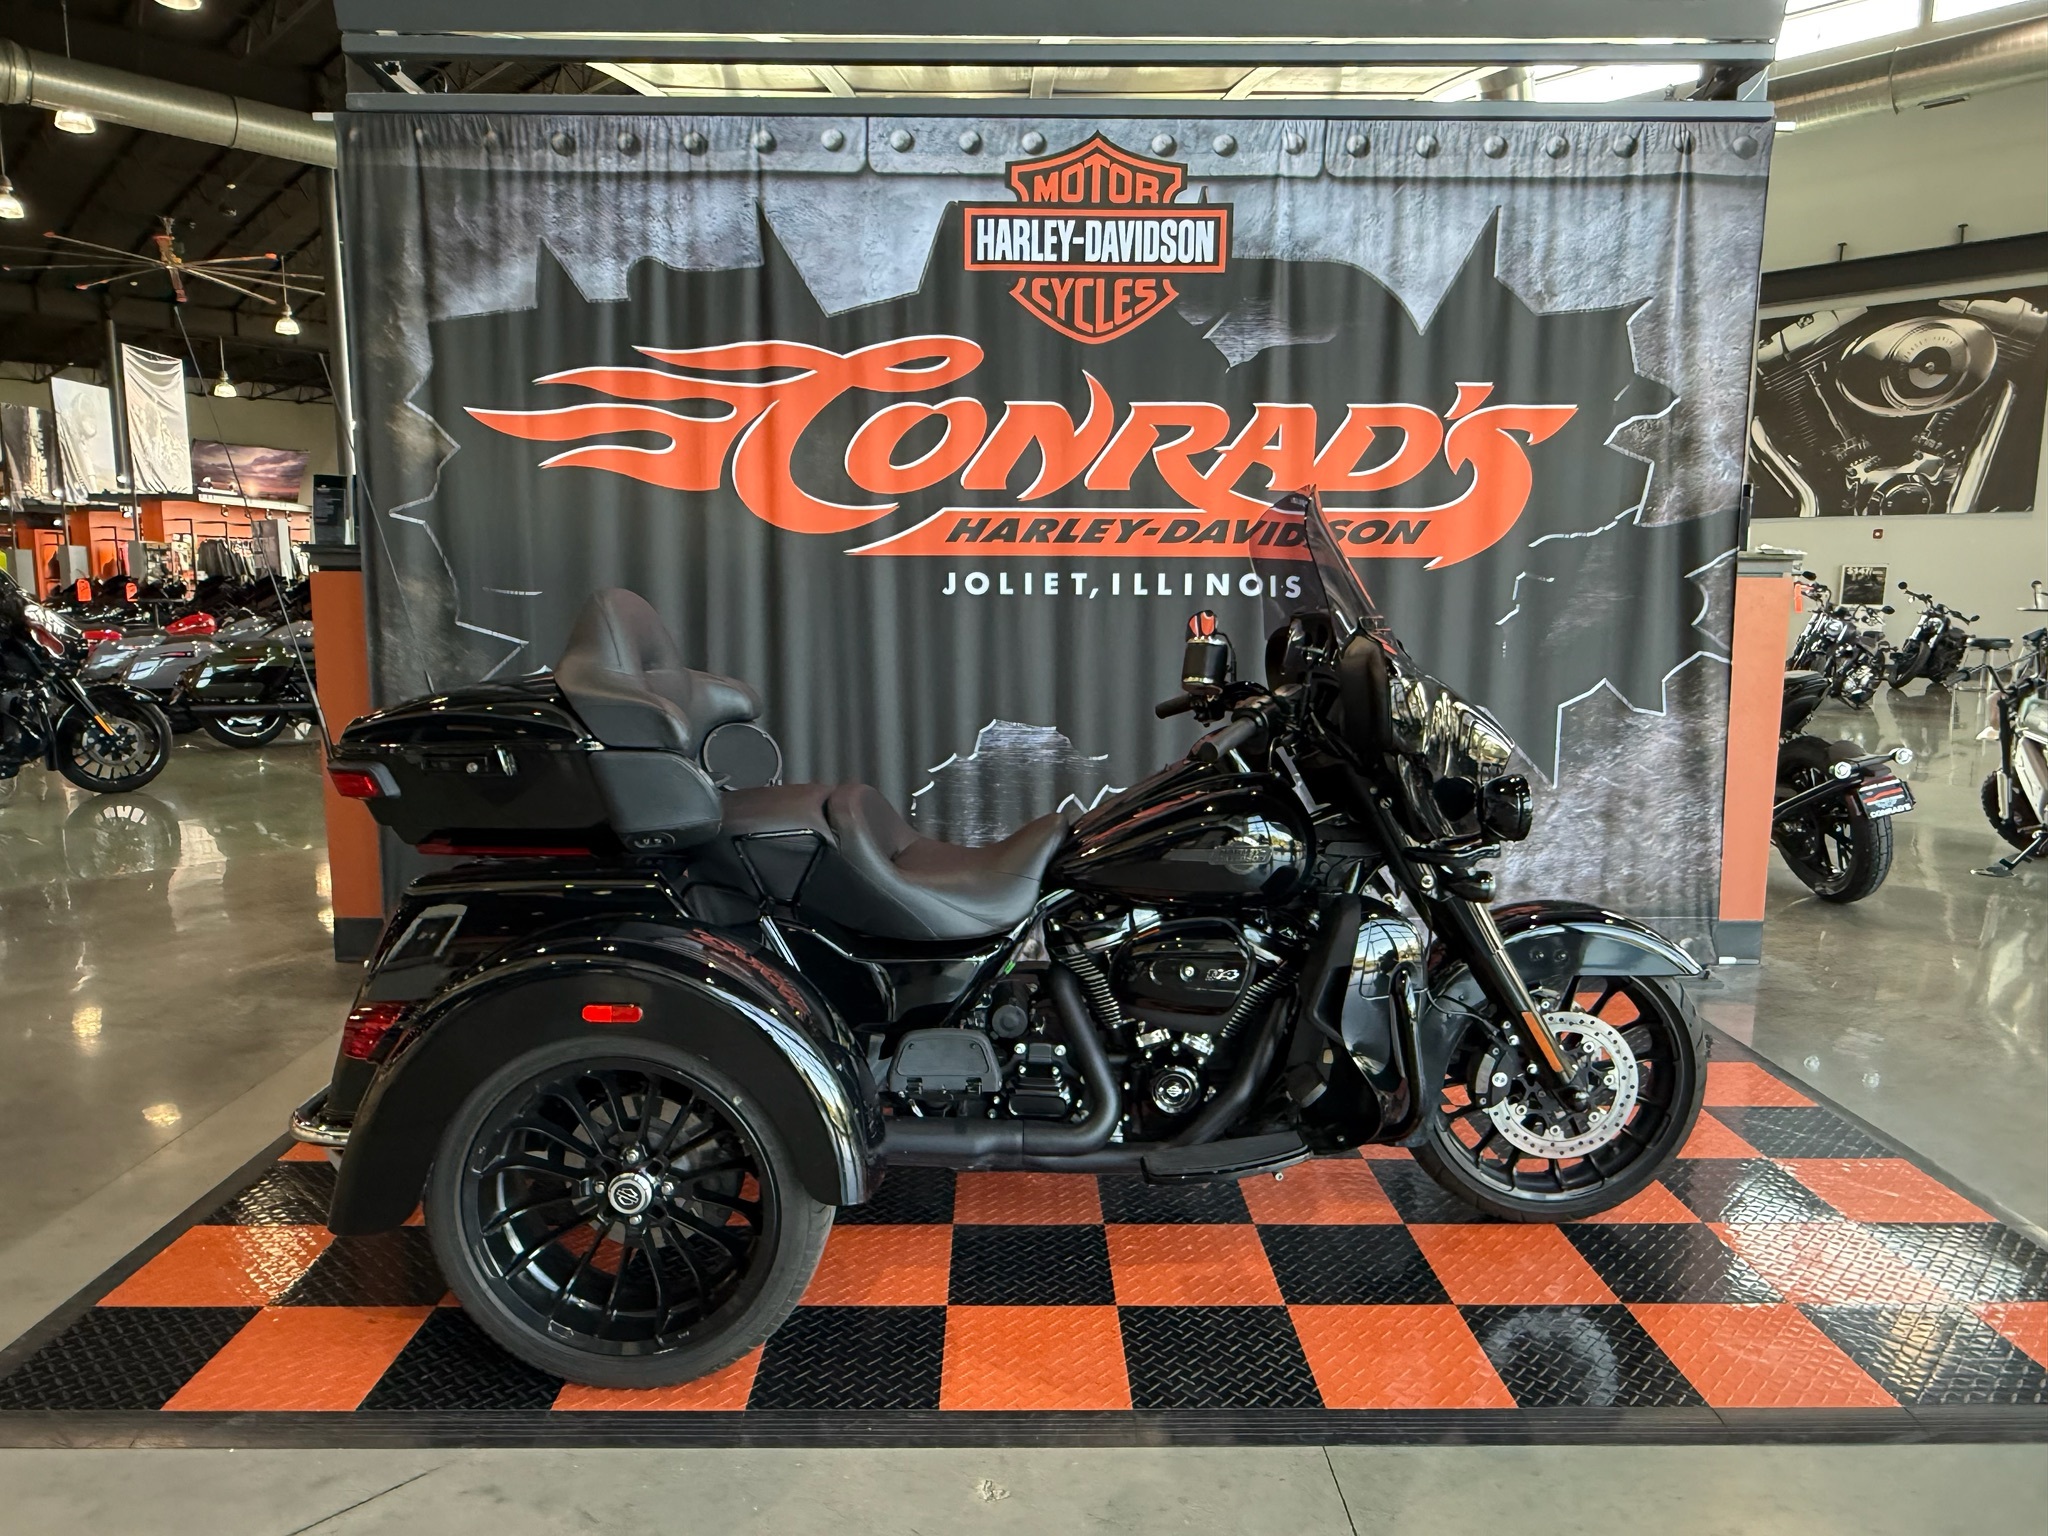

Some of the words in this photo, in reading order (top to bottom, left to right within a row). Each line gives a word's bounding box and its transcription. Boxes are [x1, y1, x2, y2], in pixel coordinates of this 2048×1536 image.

[1033, 153, 1160, 203] MOTOR
[976, 218, 1215, 264] HARLEY-DAVIDSON
[1031, 277, 1157, 334] CYCLES
[464, 334, 1578, 568] CONRAD'S
[941, 571, 1099, 600] JOLIET,
[1112, 572, 1302, 598] ILLINOIS
